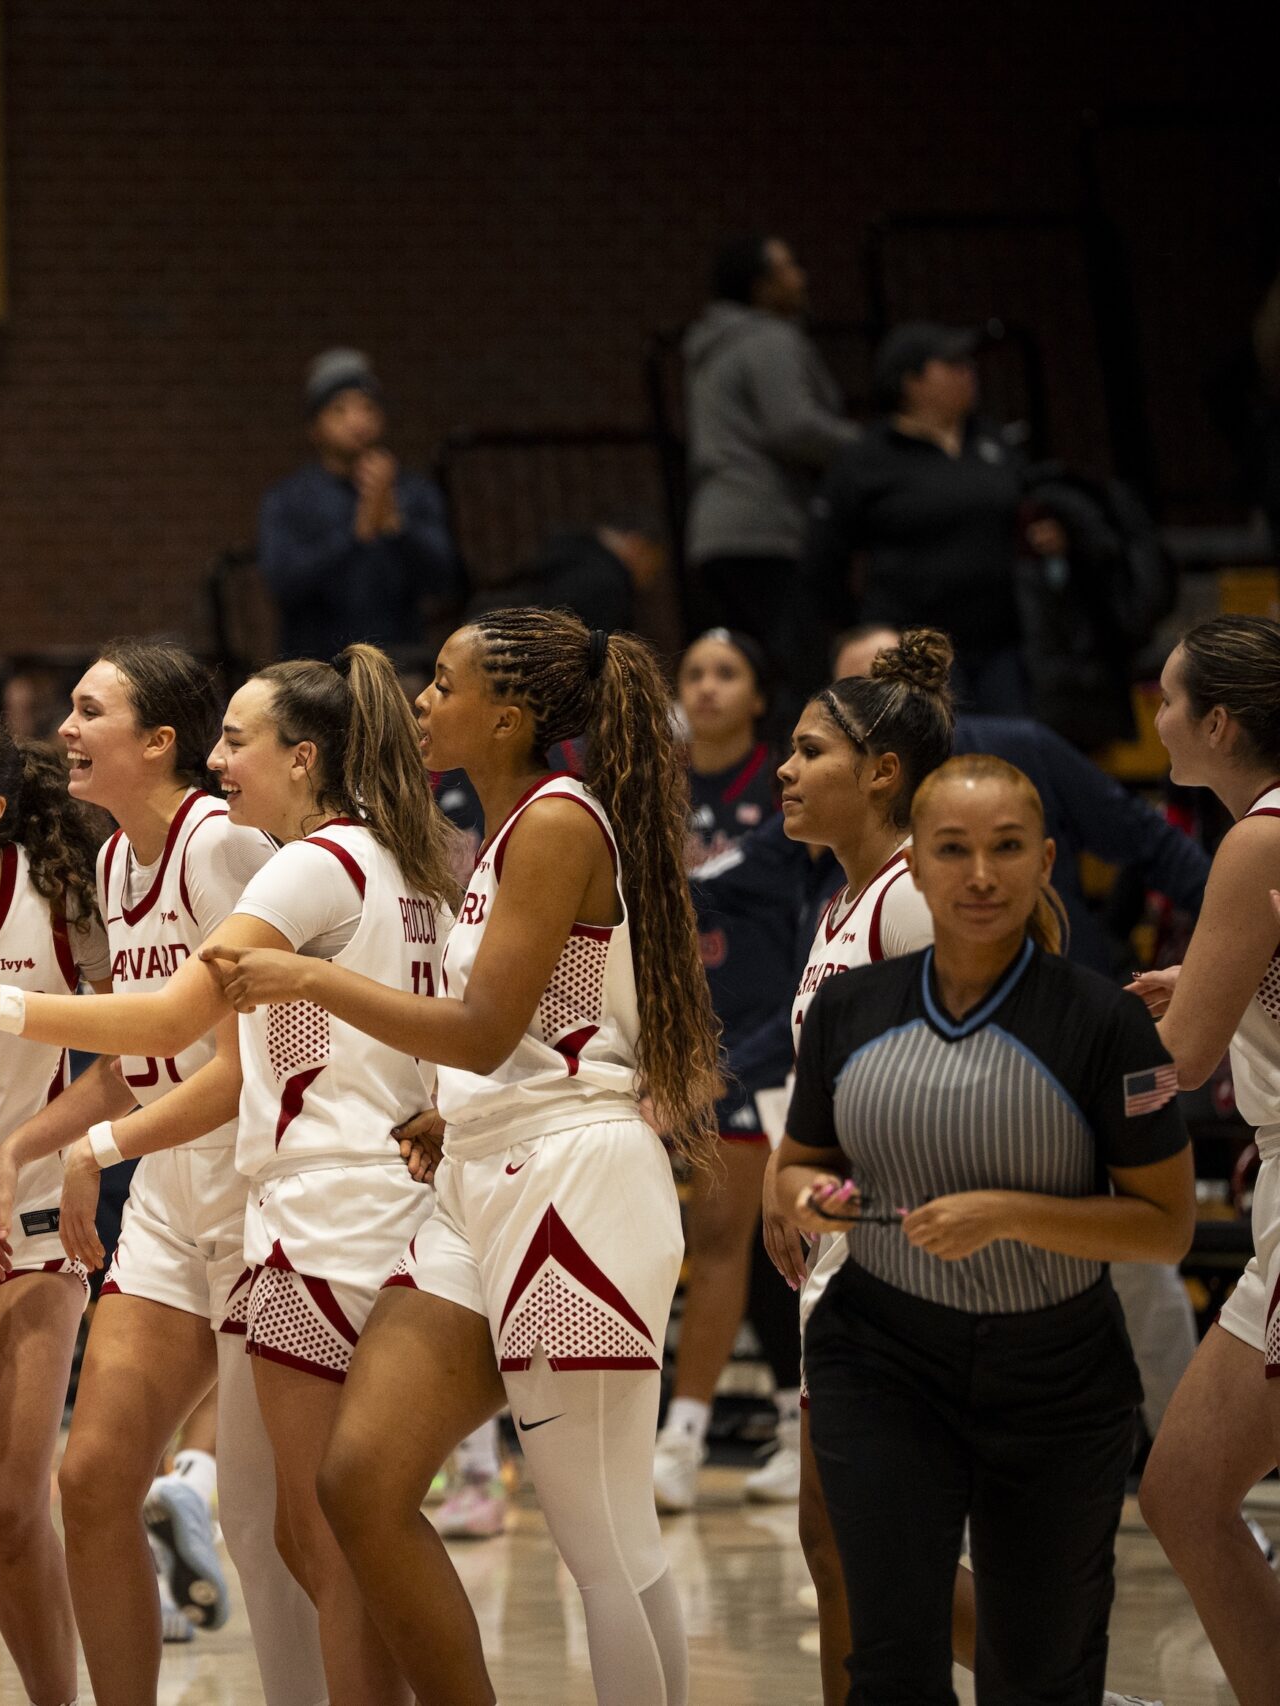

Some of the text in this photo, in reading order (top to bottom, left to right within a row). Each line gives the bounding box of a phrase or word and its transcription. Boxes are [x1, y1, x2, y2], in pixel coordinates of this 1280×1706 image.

[398, 896, 437, 945] ROCCO
[0, 958, 23, 973] Ivy
[111, 943, 191, 982] ARVARD
